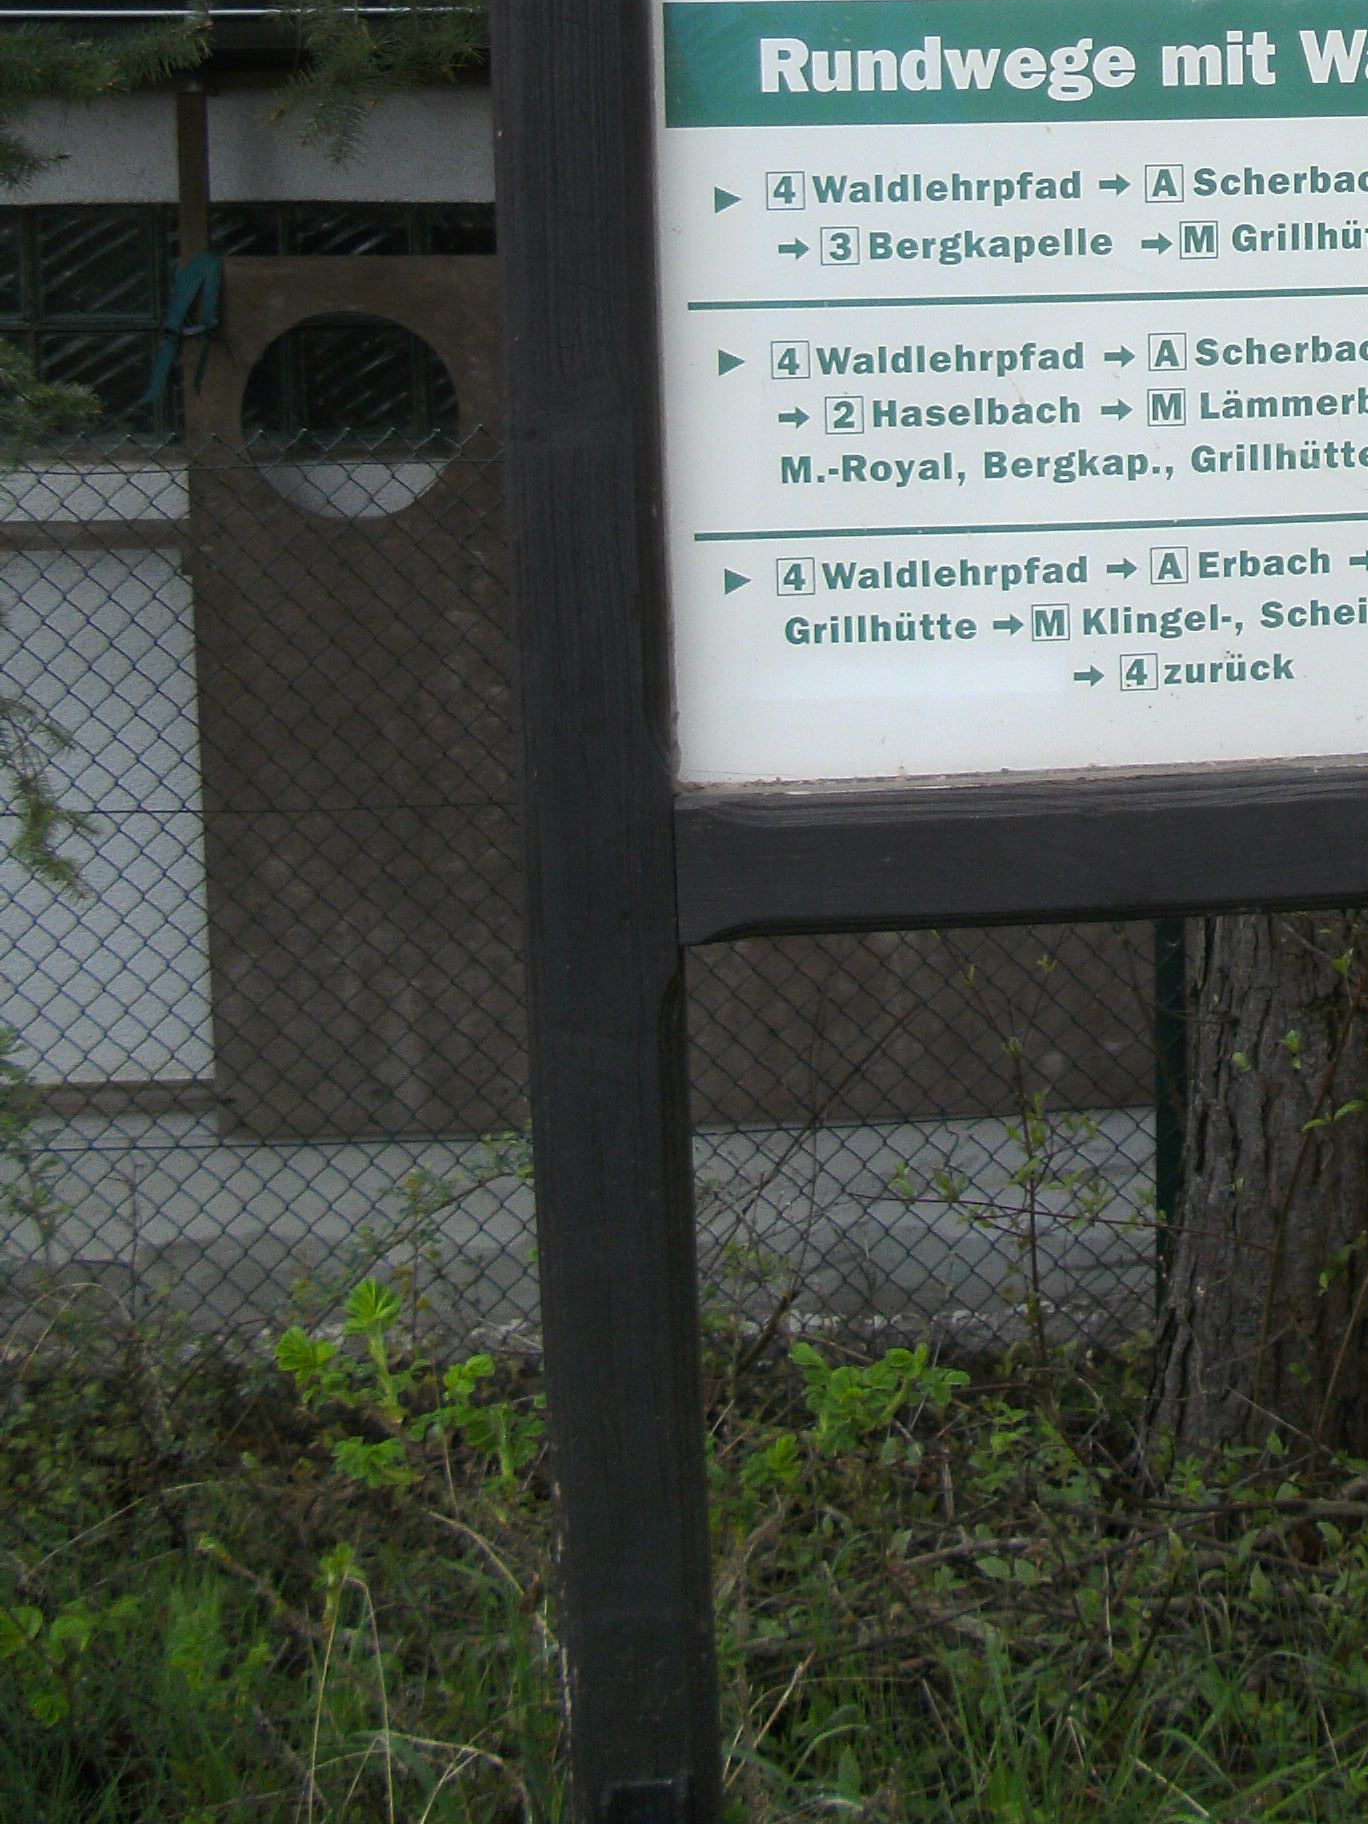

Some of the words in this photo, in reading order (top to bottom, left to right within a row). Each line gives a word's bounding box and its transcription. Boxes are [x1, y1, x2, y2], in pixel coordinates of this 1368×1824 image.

[759, 35, 1137, 102] Rundwege
[1161, 29, 1277, 87] mit
[772, 175, 796, 205] 4
[811, 170, 1081, 207] Waldlehrpfad
[1151, 168, 1178, 198] A
[829, 232, 852, 261] 3
[868, 227, 1113, 266] Bergkapelle
[1184, 224, 1215, 254] M
[777, 347, 801, 376] 4
[815, 341, 1084, 378] Waldlehrpfad
[1154, 339, 1180, 368] A
[833, 400, 855, 429] 2
[872, 395, 1080, 428] Haselbach
[1151, 392, 1182, 421] M
[780, 452, 966, 488] M.-Royal,
[983, 448, 1174, 484] Bergkap.,
[782, 563, 806, 592] 4
[821, 555, 1088, 592] Waldlehrpfad
[1157, 552, 1183, 581] A
[1198, 547, 1331, 579] Erbach
[784, 613, 977, 645] Grillhütte
[1034, 609, 1065, 638] M
[1082, 603, 1243, 640] Klingel-,
[1125, 658, 1148, 686] 4
[1163, 653, 1295, 685] zurück
